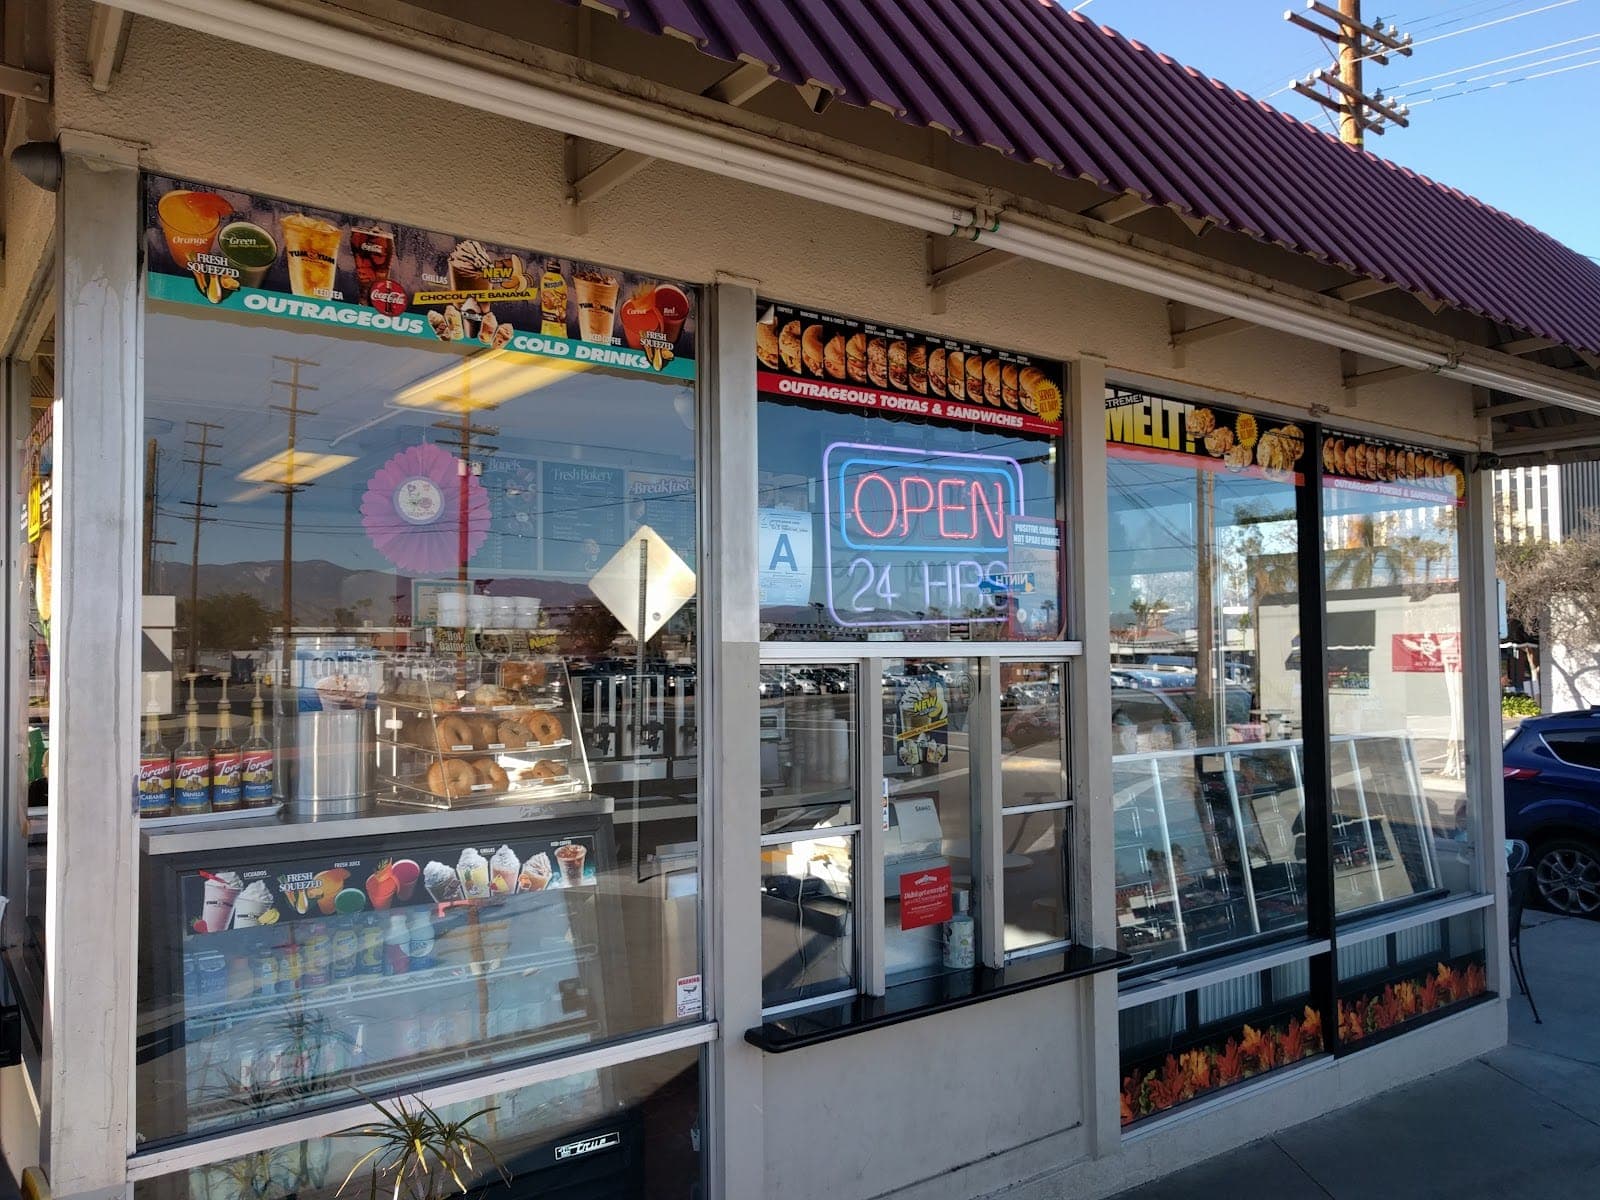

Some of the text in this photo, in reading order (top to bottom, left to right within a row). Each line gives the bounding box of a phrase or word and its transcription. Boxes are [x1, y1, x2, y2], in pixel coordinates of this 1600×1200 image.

[172, 235, 208, 246] Orange
[229, 236, 257, 246] Green
[196, 252, 228, 266] FRESH
[316, 254, 335, 265] YUM
[186, 260, 240, 280] SQUEEZED
[484, 266, 513, 278] NEW
[422, 272, 448, 284] CHILLAS
[313, 288, 344, 301] ICED TEA
[370, 289, 405, 306] Coca-Cola
[420, 290, 531, 301] CHOCOLATE BANANA
[600, 304, 614, 314] YUM
[244, 294, 652, 369] OUTRAGEOUS COLD DRINKS
[646, 330, 668, 342] FRESH
[640, 338, 674, 350] SQUEEZED
[1038, 388, 1056, 400] SERVED
[778, 379, 1024, 428] OUTRAGEOUS TORTAS & SANDWICHES
[1105, 393, 1144, 410] TREME!
[1105, 387, 1196, 453] MELT!
[552, 468, 581, 482] Fresh
[633, 479, 691, 496] Breakfast
[854, 472, 1004, 540] OPEN
[1013, 534, 1024, 544] NOT
[768, 534, 798, 572] A
[850, 558, 1009, 612] 24 HRS
[216, 760, 240, 776] Tora
[286, 872, 314, 883] FRESH
[279, 879, 322, 892] SQUEEZED
